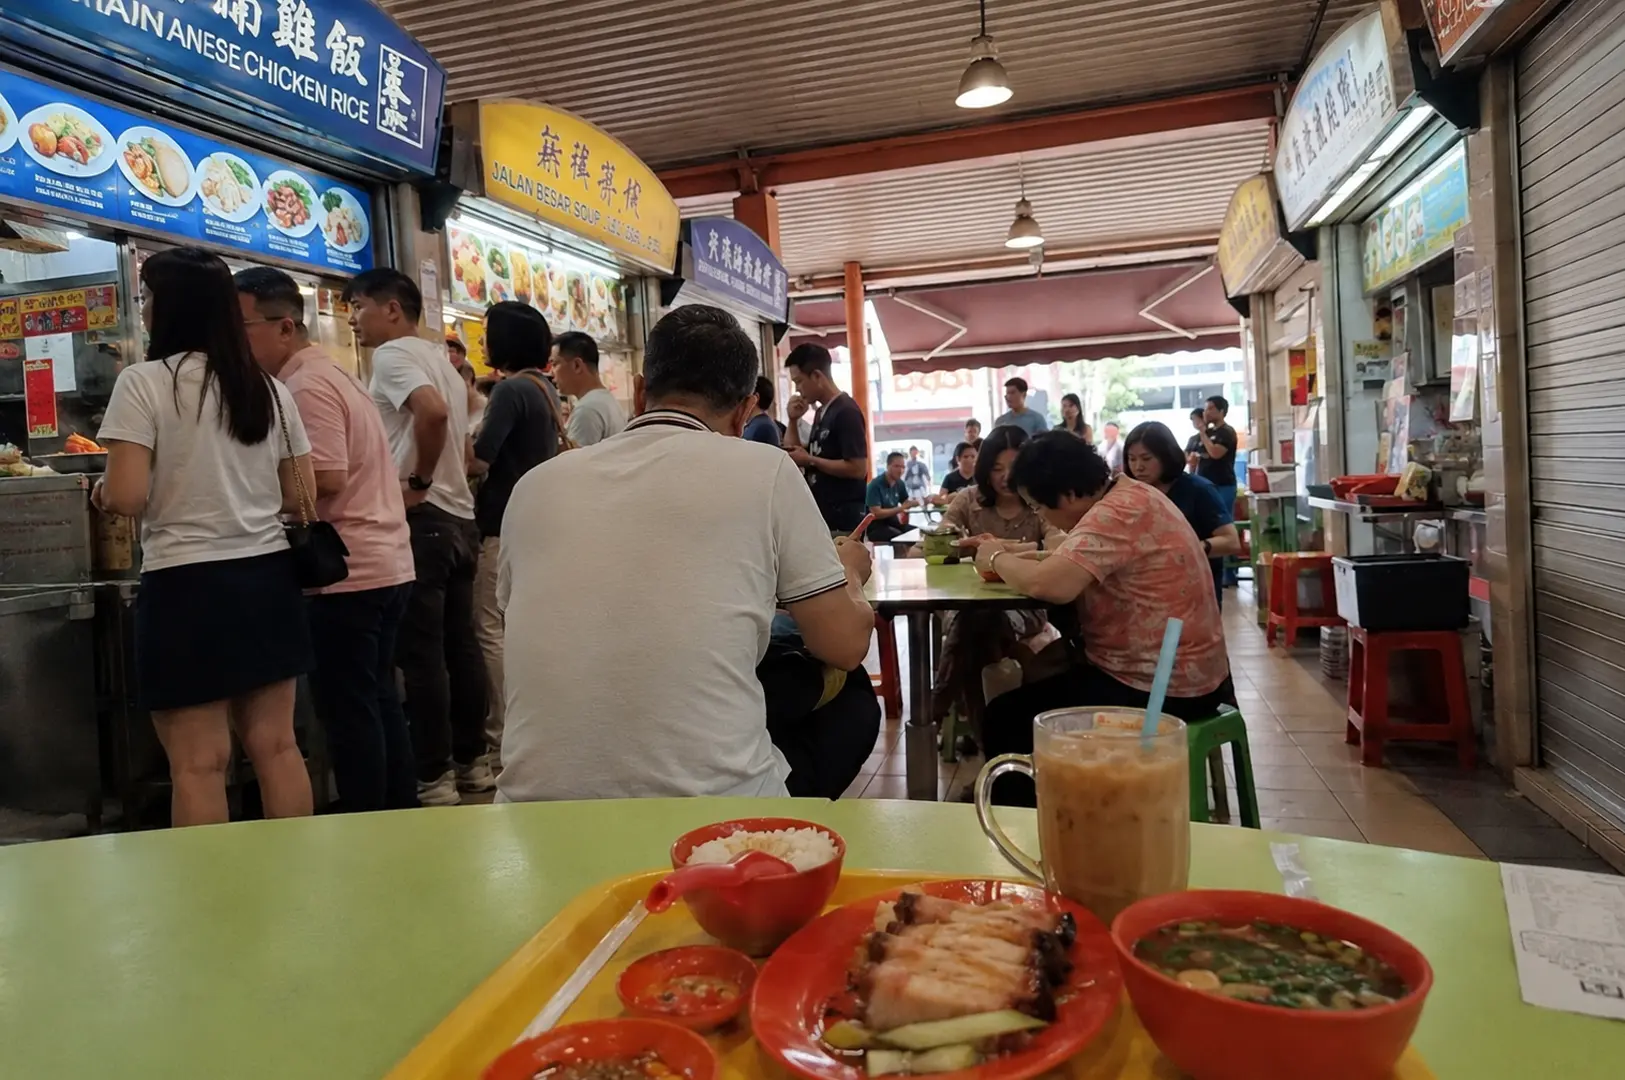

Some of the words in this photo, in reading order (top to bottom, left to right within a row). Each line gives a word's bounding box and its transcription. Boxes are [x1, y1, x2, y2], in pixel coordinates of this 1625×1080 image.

[244, 51, 327, 107] CHICKEN
[330, 88, 369, 125] RICE
[492, 162, 534, 196] JALAN
[536, 182, 571, 213] BESAR
[573, 201, 601, 225] SOUP
